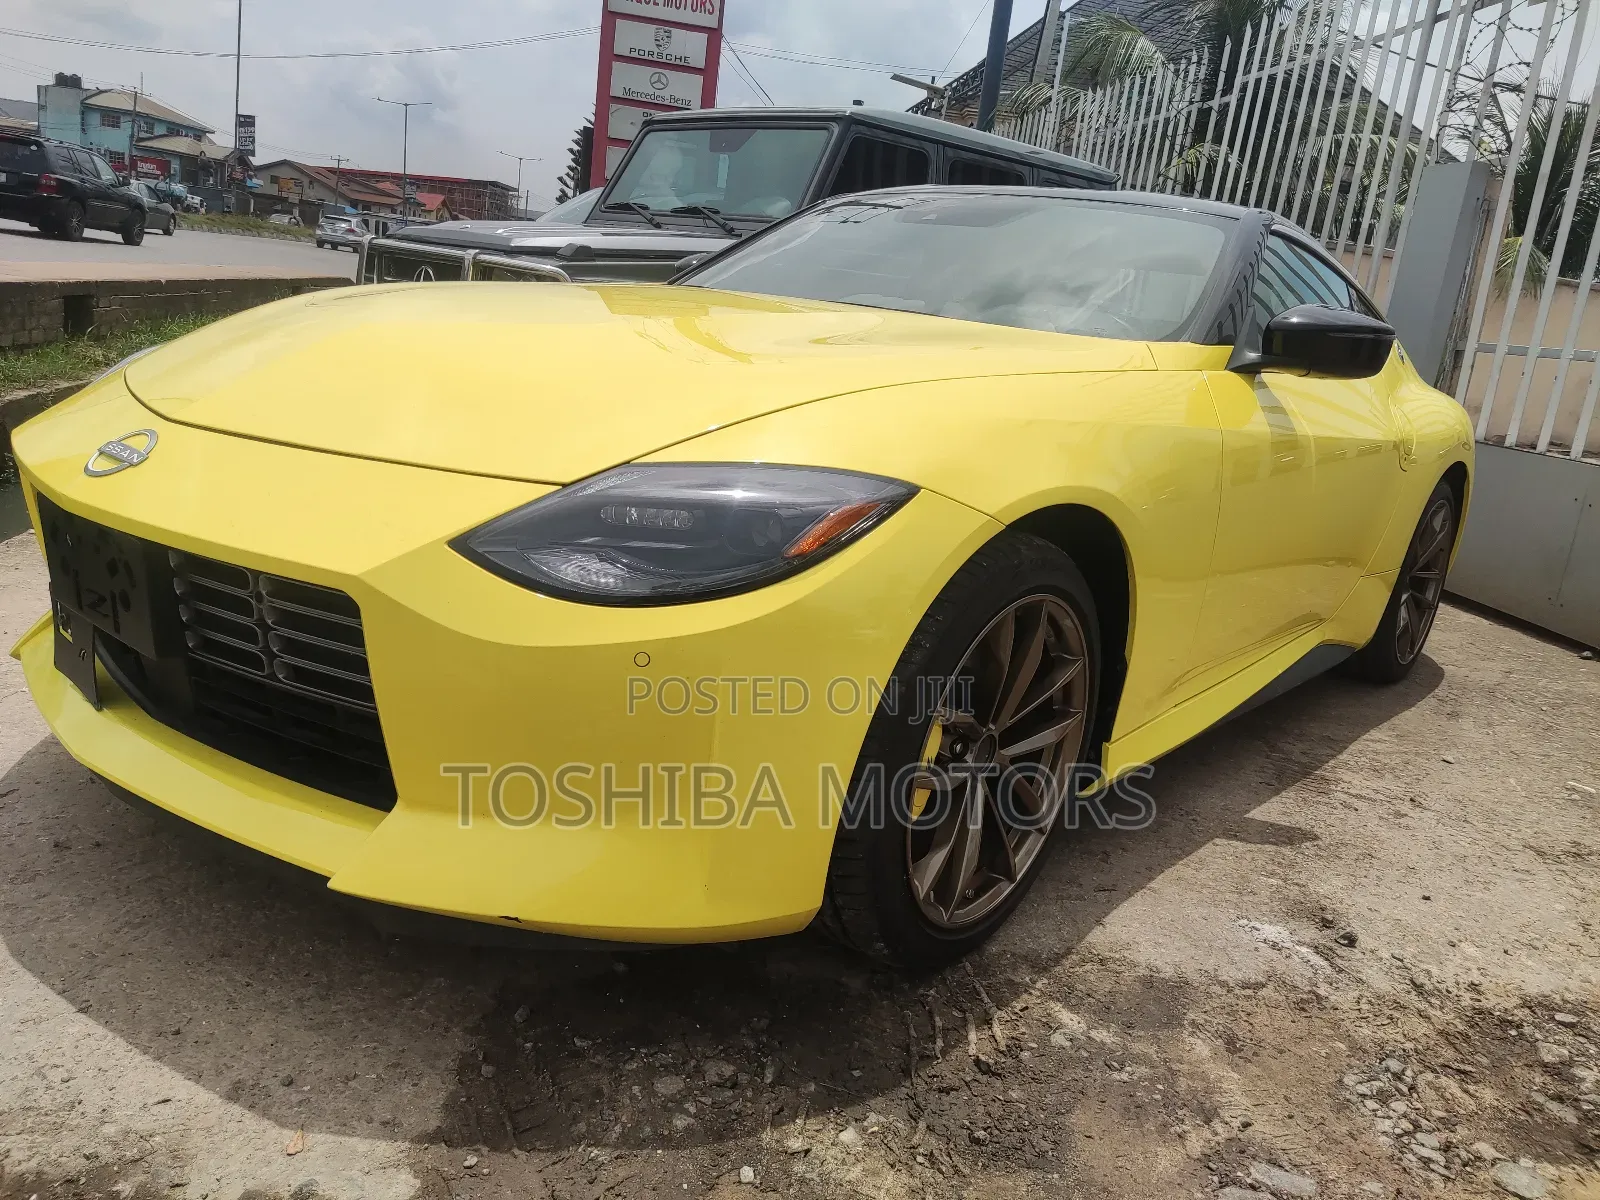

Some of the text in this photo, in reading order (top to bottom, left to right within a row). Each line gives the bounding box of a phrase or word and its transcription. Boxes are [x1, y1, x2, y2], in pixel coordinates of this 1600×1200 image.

[629, 47, 691, 64] PORSCHE
[622, 86, 692, 107] Mercedes-Benz
[105, 443, 144, 463] SSAN
